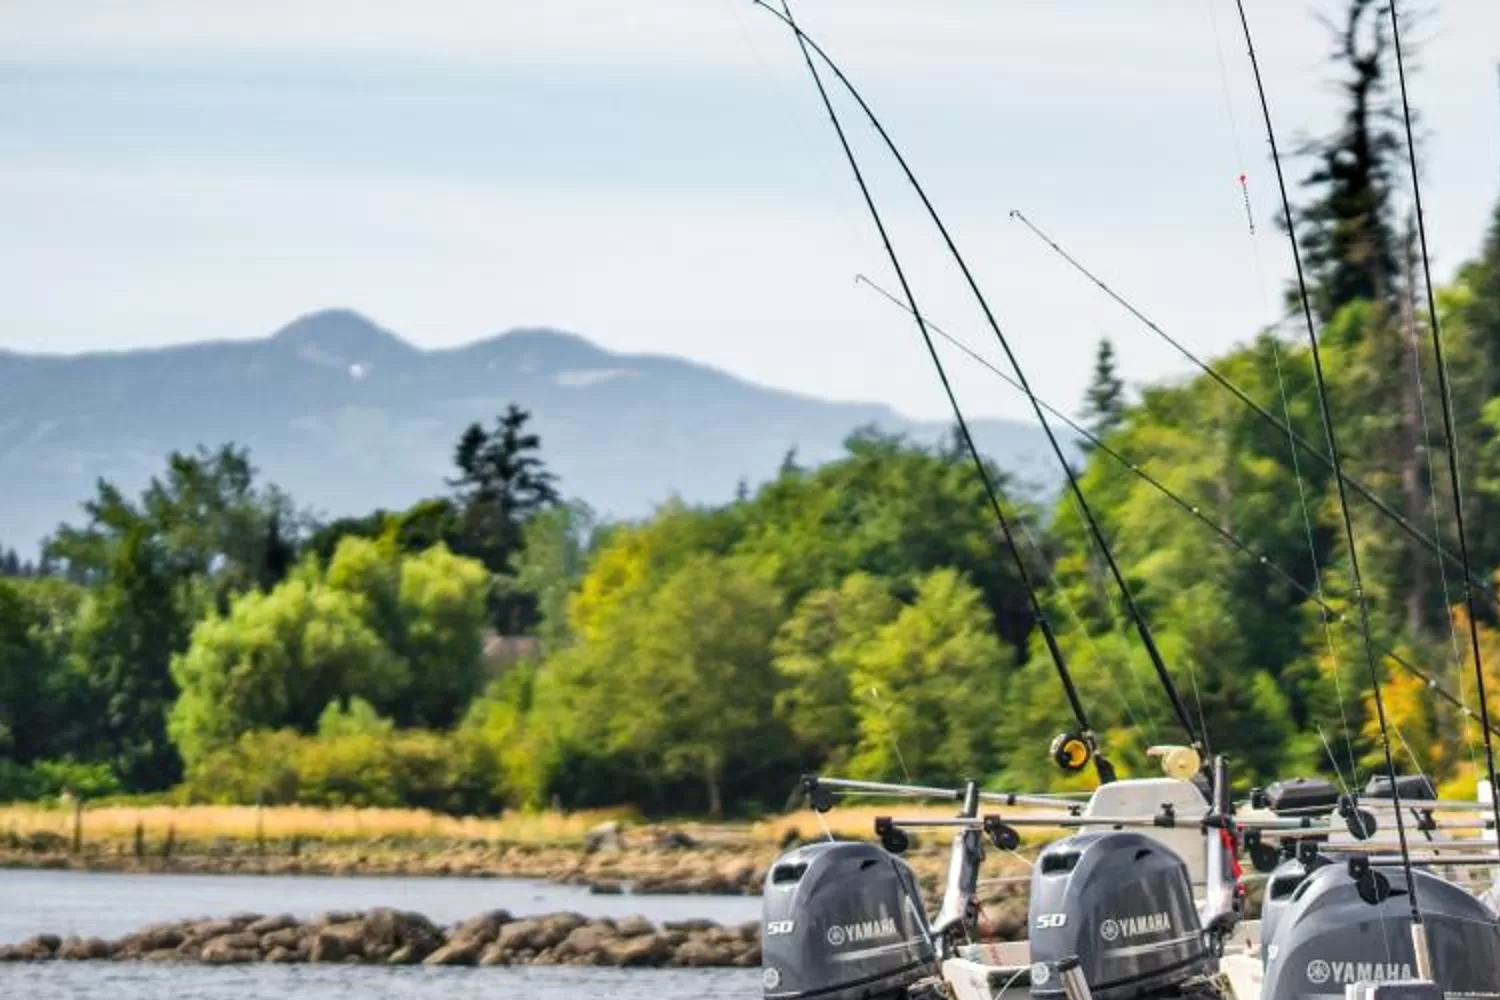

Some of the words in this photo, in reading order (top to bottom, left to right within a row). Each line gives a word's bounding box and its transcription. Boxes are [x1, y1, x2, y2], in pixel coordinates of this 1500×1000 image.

[767, 919, 795, 936] 50
[844, 917, 897, 942] YAMAHA
[1035, 913, 1068, 929] 50
[1119, 911, 1172, 938] YAMAHA
[1330, 960, 1412, 983] YAMAHA
